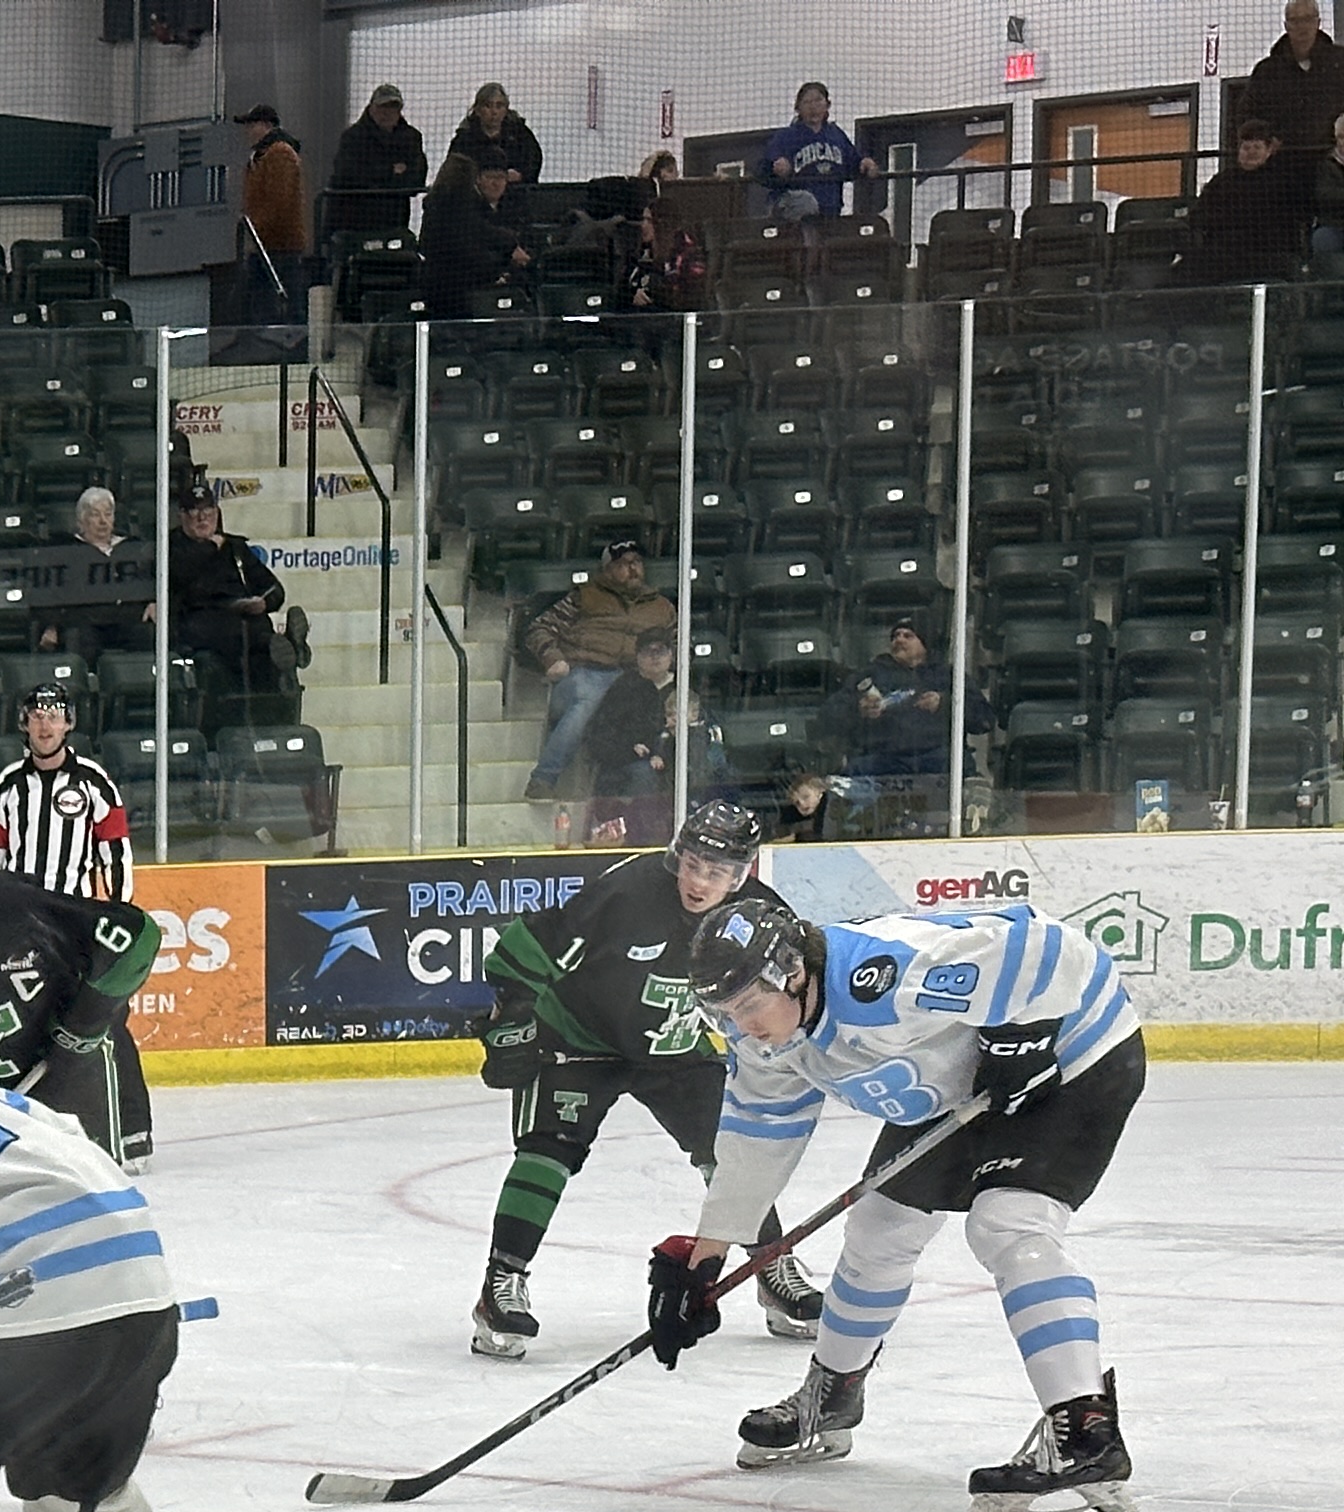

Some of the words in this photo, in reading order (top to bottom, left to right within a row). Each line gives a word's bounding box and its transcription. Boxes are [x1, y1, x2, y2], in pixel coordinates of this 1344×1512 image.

[176, 404, 223, 421] CFRY
[291, 402, 338, 417] CRY
[291, 421, 313, 432] 92
[315, 473, 351, 500] MIX
[271, 545, 401, 572] PortageOnlie
[698, 834, 727, 849] CCM
[916, 868, 1030, 907] genAG
[915, 961, 981, 1014] 18
